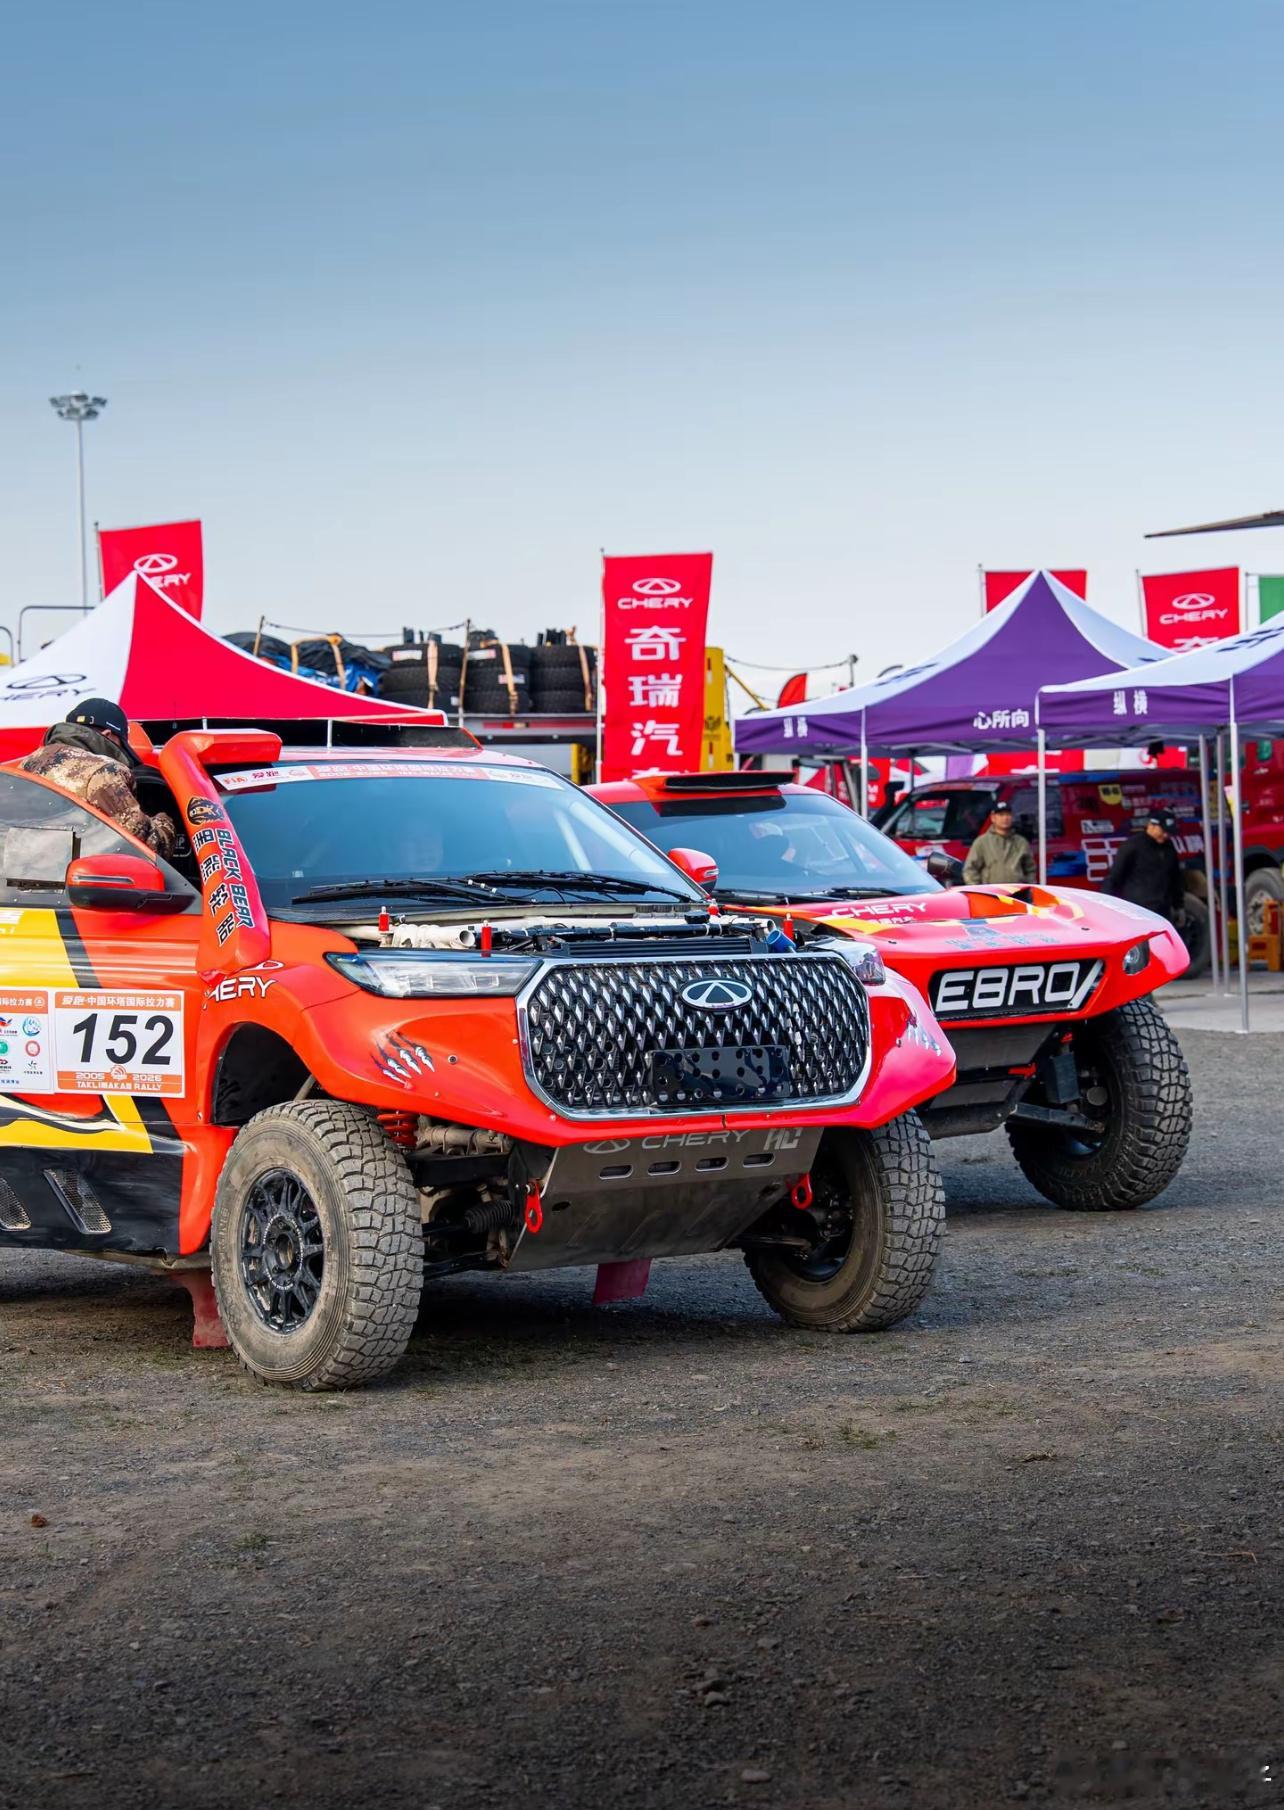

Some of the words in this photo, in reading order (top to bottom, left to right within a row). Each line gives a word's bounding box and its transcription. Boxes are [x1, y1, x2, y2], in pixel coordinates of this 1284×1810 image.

[148, 572, 192, 588] ERY
[617, 597, 694, 610] CHERY
[1159, 608, 1229, 625] CHERY
[623, 625, 688, 781] 奇瑞汽
[973, 709, 1030, 730] 心所向
[214, 827, 243, 883] BLACK
[228, 882, 256, 929] BEAR
[831, 902, 928, 920] CHERY
[204, 976, 279, 1003] ERY
[72, 1013, 175, 1066] 152
[77, 1081, 132, 1090] TAKLIMAKAN
[134, 1082, 162, 1091] RALLY
[641, 1129, 751, 1150] CHERY
